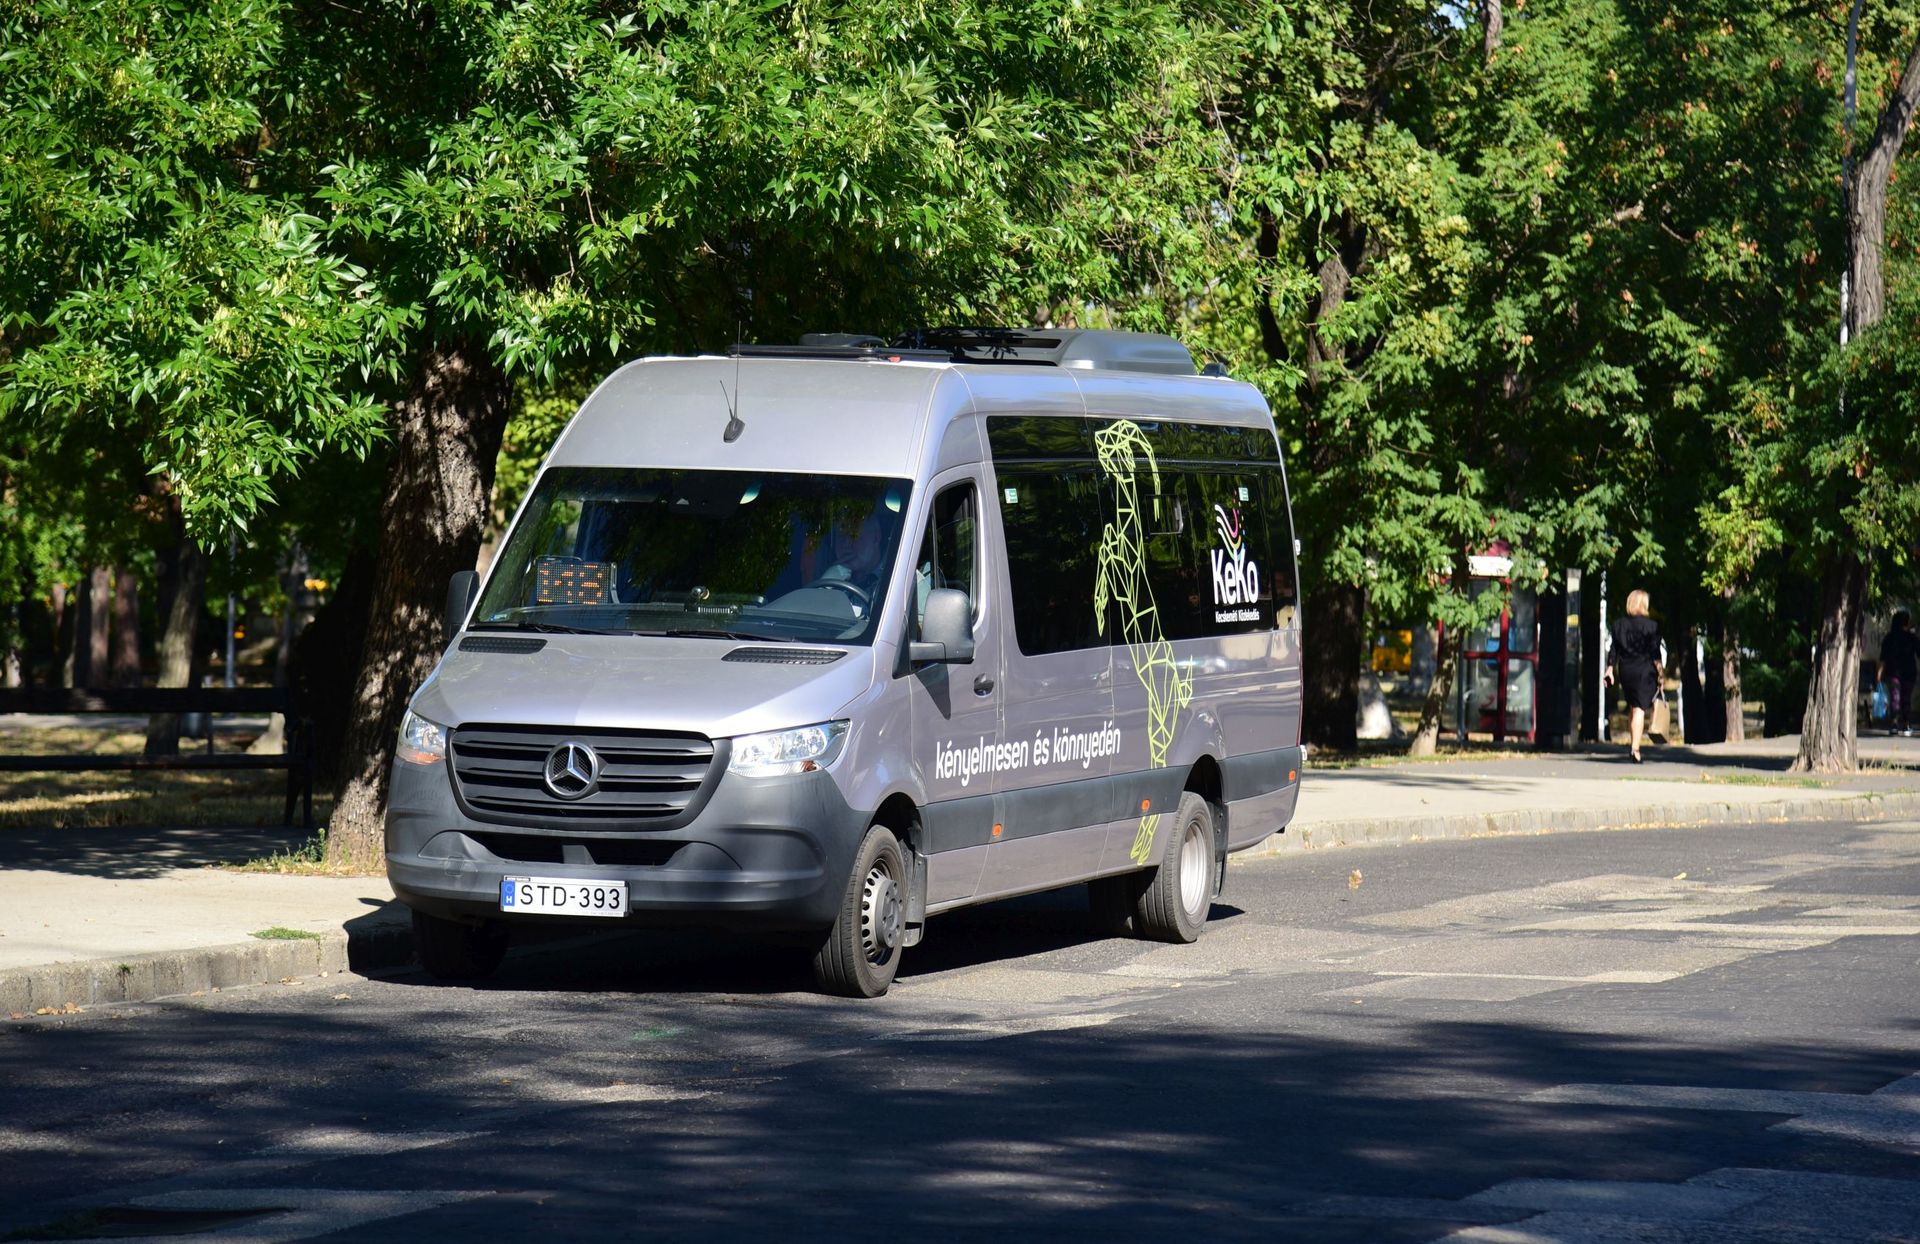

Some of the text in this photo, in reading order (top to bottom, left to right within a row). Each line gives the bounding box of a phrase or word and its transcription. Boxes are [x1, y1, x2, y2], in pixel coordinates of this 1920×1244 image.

[1211, 549, 1259, 605] KeKo
[935, 720, 1121, 787] kényelmesen és könnyedén
[505, 884, 620, 909] H STD-393
